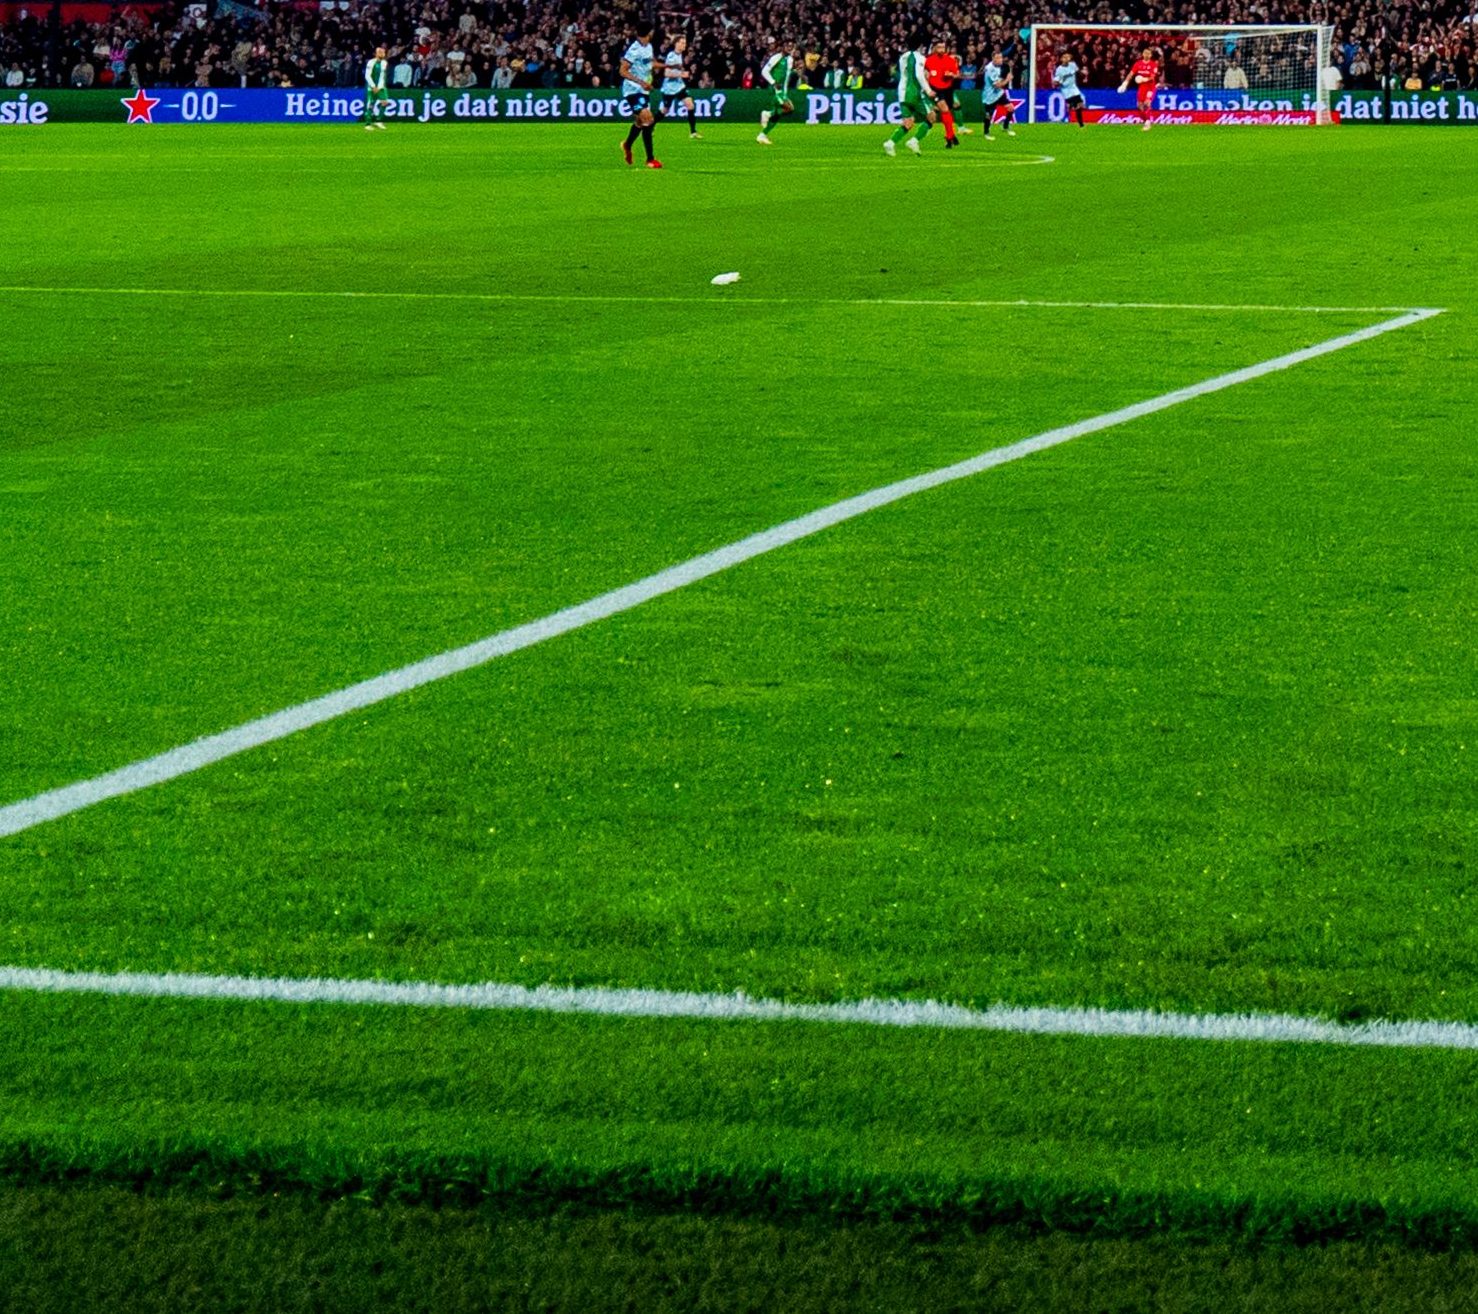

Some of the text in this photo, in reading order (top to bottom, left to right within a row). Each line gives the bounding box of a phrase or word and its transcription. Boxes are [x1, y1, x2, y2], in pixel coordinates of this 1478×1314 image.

[285, 93, 414, 117] Heineen
[418, 93, 446, 122] je
[453, 93, 499, 118] dat
[505, 93, 561, 118] niet
[568, 93, 634, 118] hore
[806, 93, 902, 125] Pilsie
[1335, 94, 1382, 120] dat
[1391, 95, 1448, 120] niet
